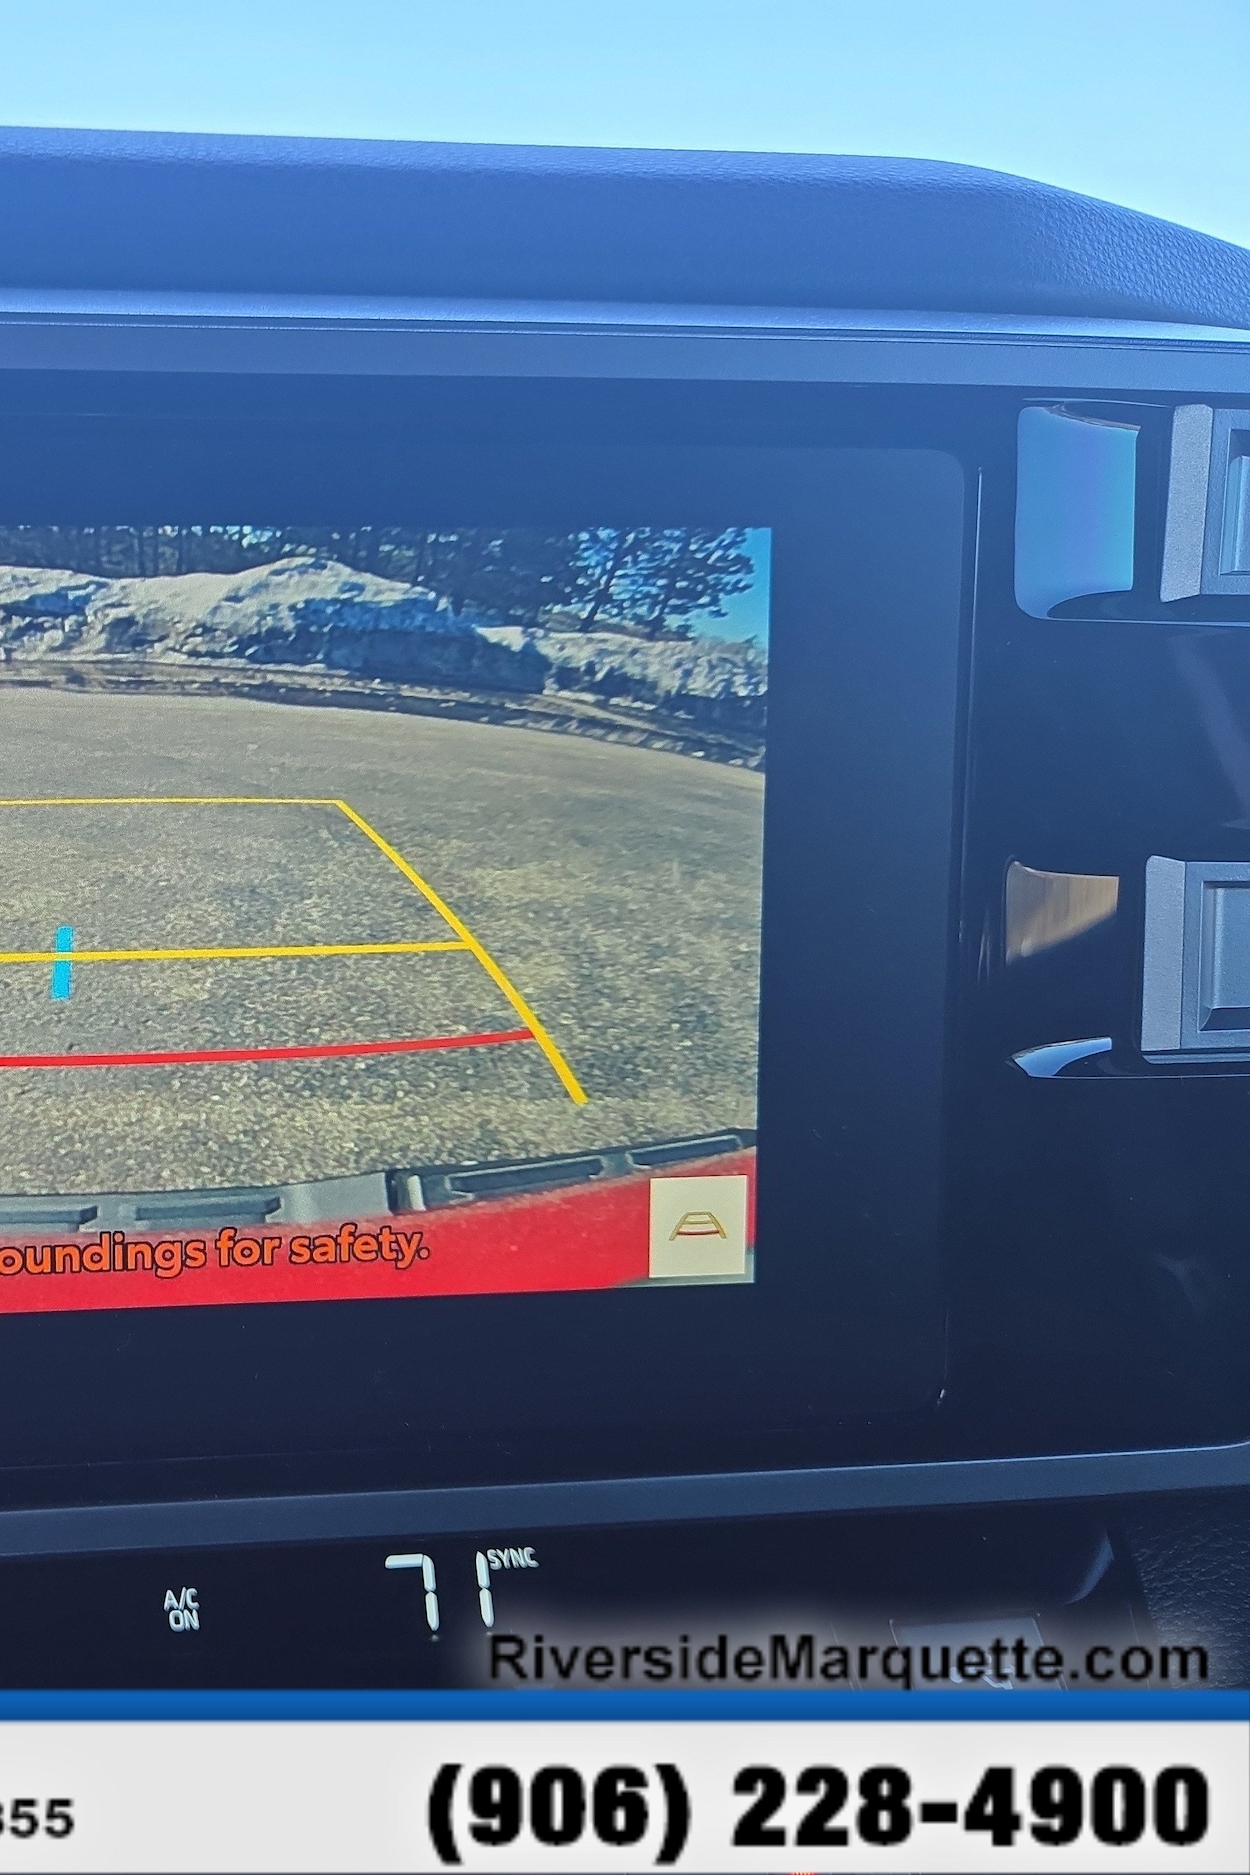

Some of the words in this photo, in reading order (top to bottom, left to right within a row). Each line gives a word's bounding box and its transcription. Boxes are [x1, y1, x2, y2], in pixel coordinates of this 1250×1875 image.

[214, 1226, 283, 1268] for
[288, 1222, 432, 1271] safety.
[486, 1546, 540, 1571] SYNC
[163, 1586, 201, 1612] A/C
[384, 1551, 495, 1632] 71
[168, 1608, 201, 1633] ON
